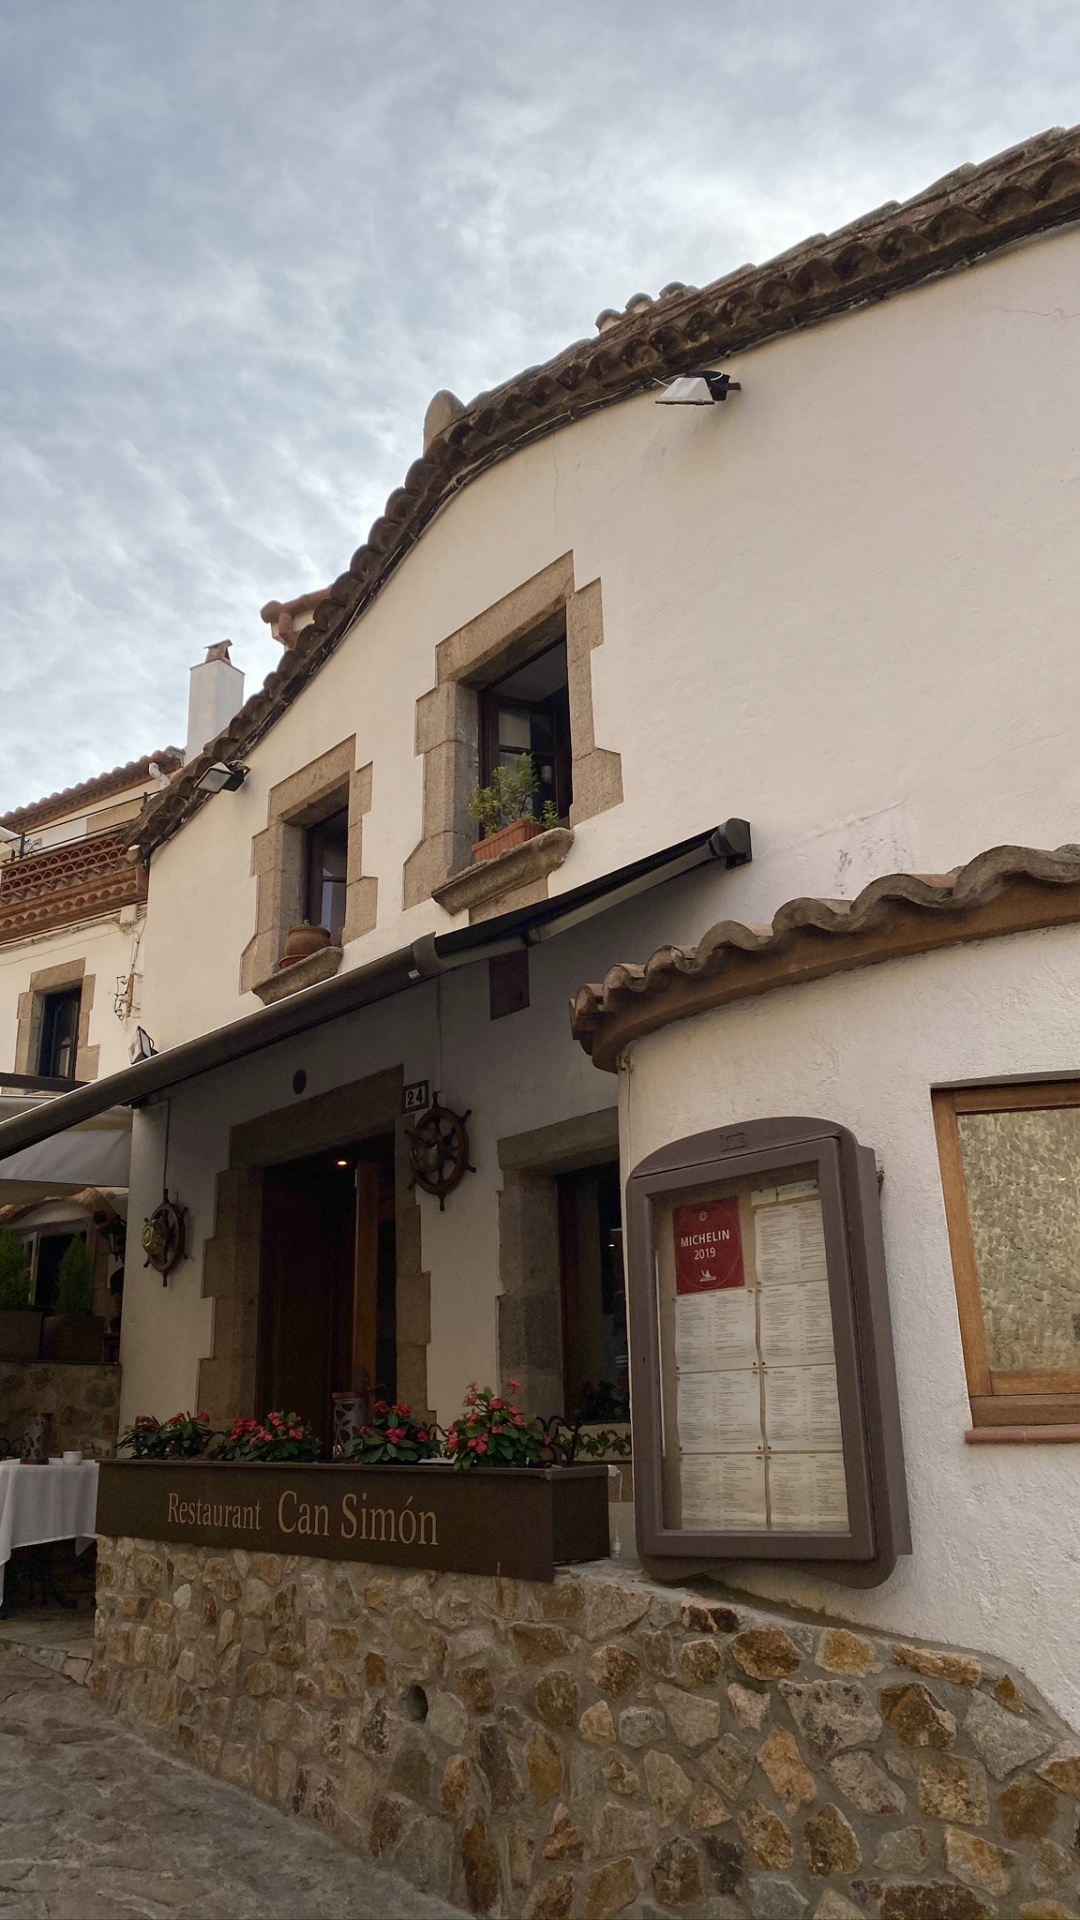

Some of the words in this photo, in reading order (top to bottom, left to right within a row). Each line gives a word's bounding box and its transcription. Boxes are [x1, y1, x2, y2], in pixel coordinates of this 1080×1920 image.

[407, 1088, 423, 1106] 24
[680, 1229, 730, 1248] MICHELIN
[694, 1247, 716, 1260] 2019
[167, 1492, 262, 1531] Restaurant
[277, 1490, 330, 1536] Can
[341, 1492, 439, 1546] Simón
